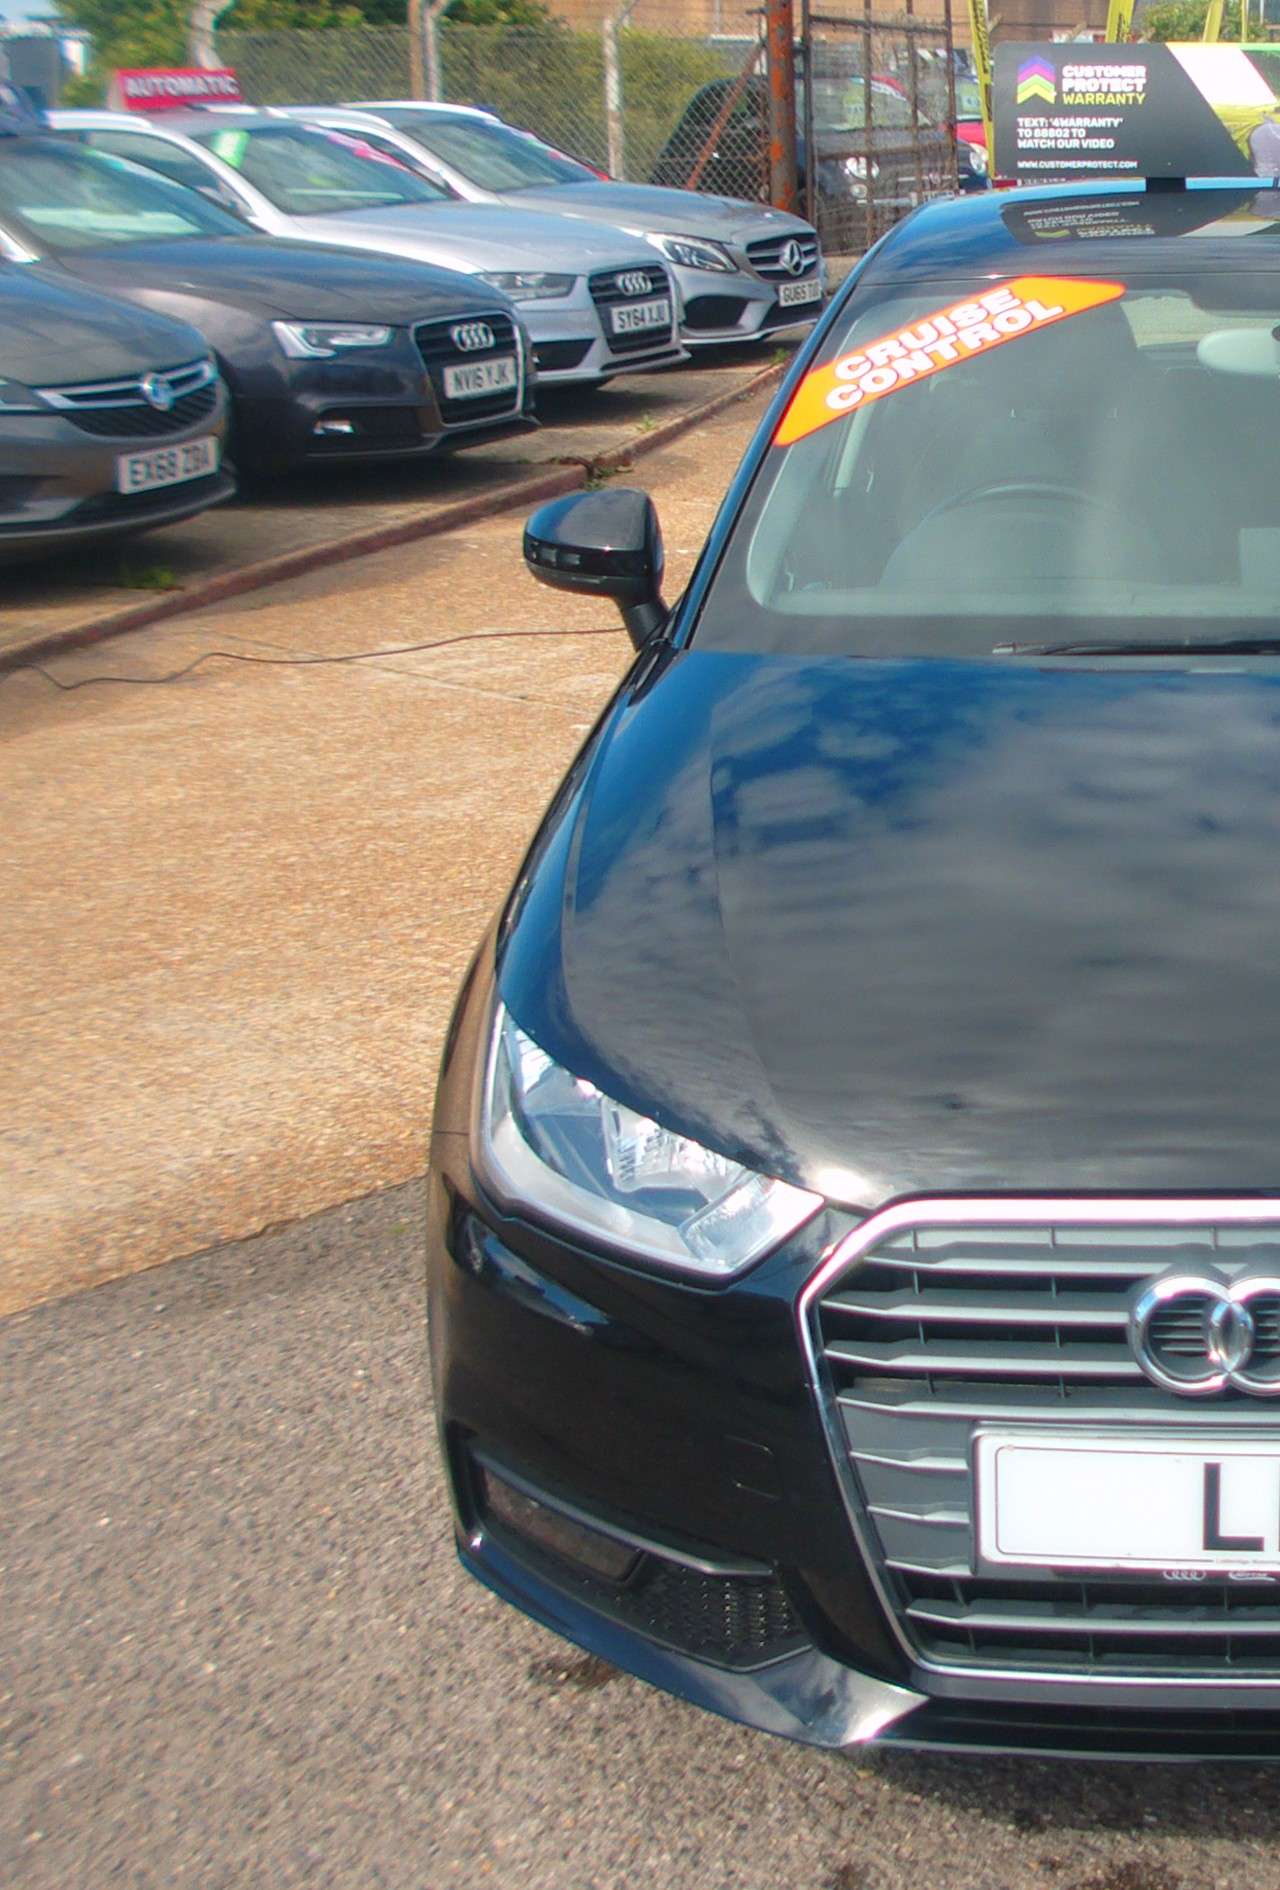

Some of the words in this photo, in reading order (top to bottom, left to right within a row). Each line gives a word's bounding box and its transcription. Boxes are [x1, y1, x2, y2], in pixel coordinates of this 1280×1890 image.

[1062, 65, 1146, 78] CUSTOMER
[125, 75, 240, 97] AUTOMATIC
[1062, 78, 1147, 92] PROTECT
[1062, 93, 1147, 105] WARRANTY
[1016, 117, 1049, 128] TEXT:
[1016, 128, 1033, 138] TO
[1071, 128, 1087, 138] TO
[1016, 138, 1056, 149] WATCH
[1057, 138, 1080, 149] OUR
[1081, 138, 1115, 149] VIDEO
[834, 288, 1023, 381] CRUISE
[824, 300, 1064, 410] CONTROL
[127, 449, 179, 486] EX68
